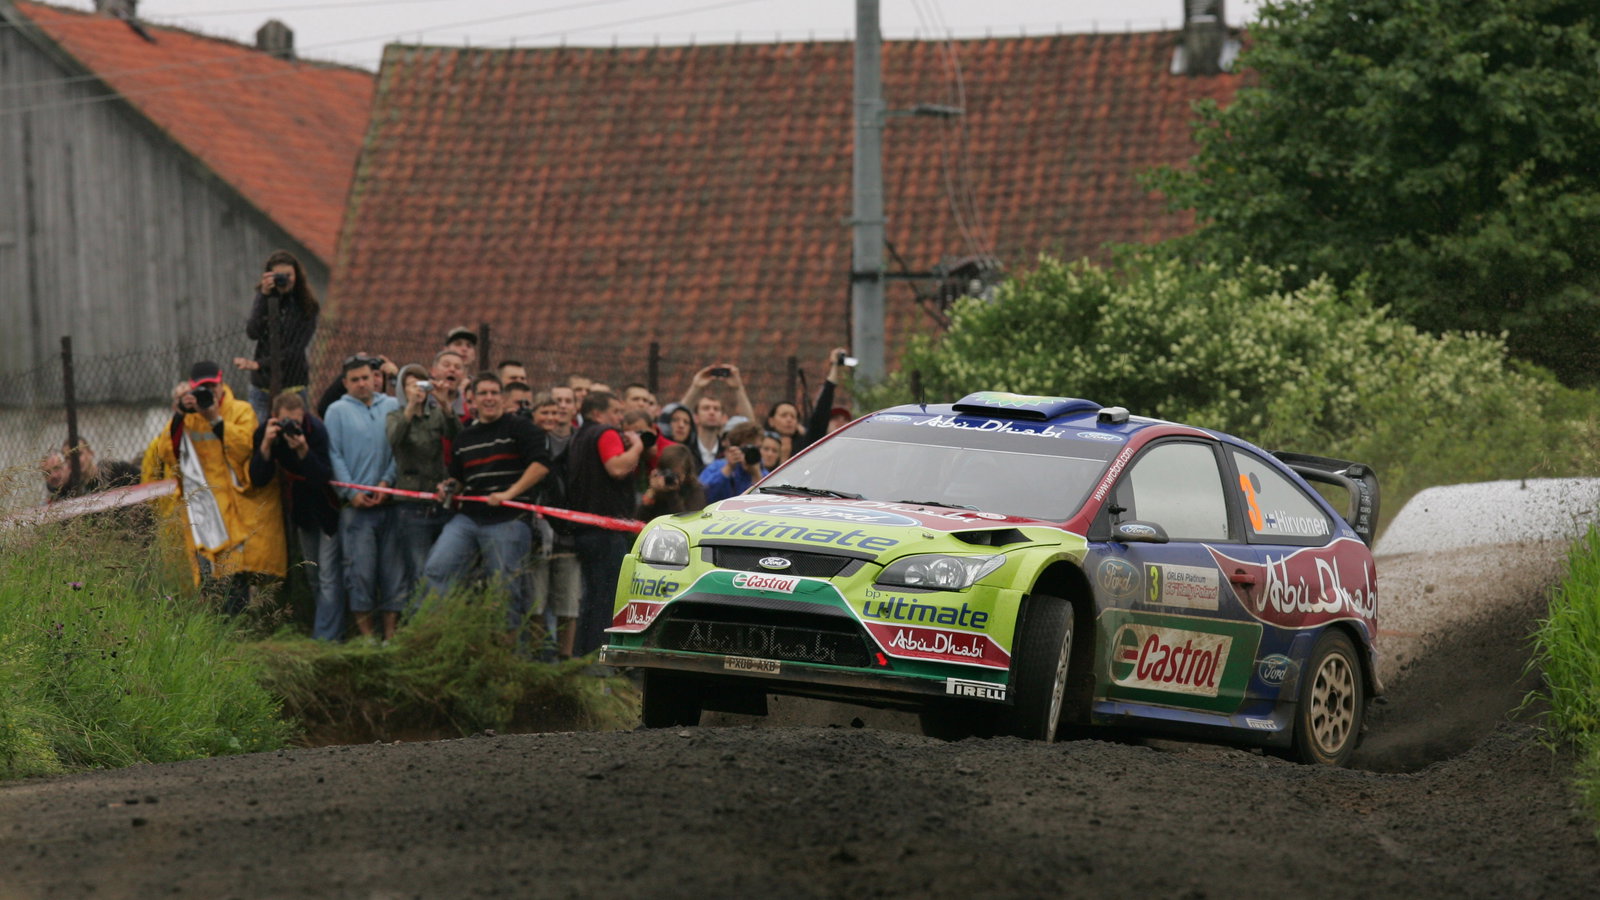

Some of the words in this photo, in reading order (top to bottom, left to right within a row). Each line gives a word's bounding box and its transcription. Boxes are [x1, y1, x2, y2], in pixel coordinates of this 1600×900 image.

[913, 414, 977, 431] Abu
[976, 419, 1067, 439] Dhabi
[1093, 447, 1134, 502] www.wrcford.com
[768, 504, 887, 523] Ford
[1239, 473, 1263, 532] 3
[701, 519, 899, 552] ultimate
[1273, 510, 1331, 535] Hirvonen
[746, 575, 794, 592] Castrol
[1104, 562, 1132, 591] Ford
[1150, 565, 1159, 602] 3
[1166, 571, 1184, 581] ORLEN
[1256, 553, 1312, 614] Abu
[865, 588, 881, 600] bp
[862, 596, 989, 630] ultimate
[745, 625, 839, 662] Dhabi
[888, 629, 935, 652] Abu
[933, 632, 984, 658] Dhabi
[1136, 633, 1223, 688] Castrol
[1263, 659, 1288, 680] Ford
[946, 677, 1006, 700] PIRELLI
